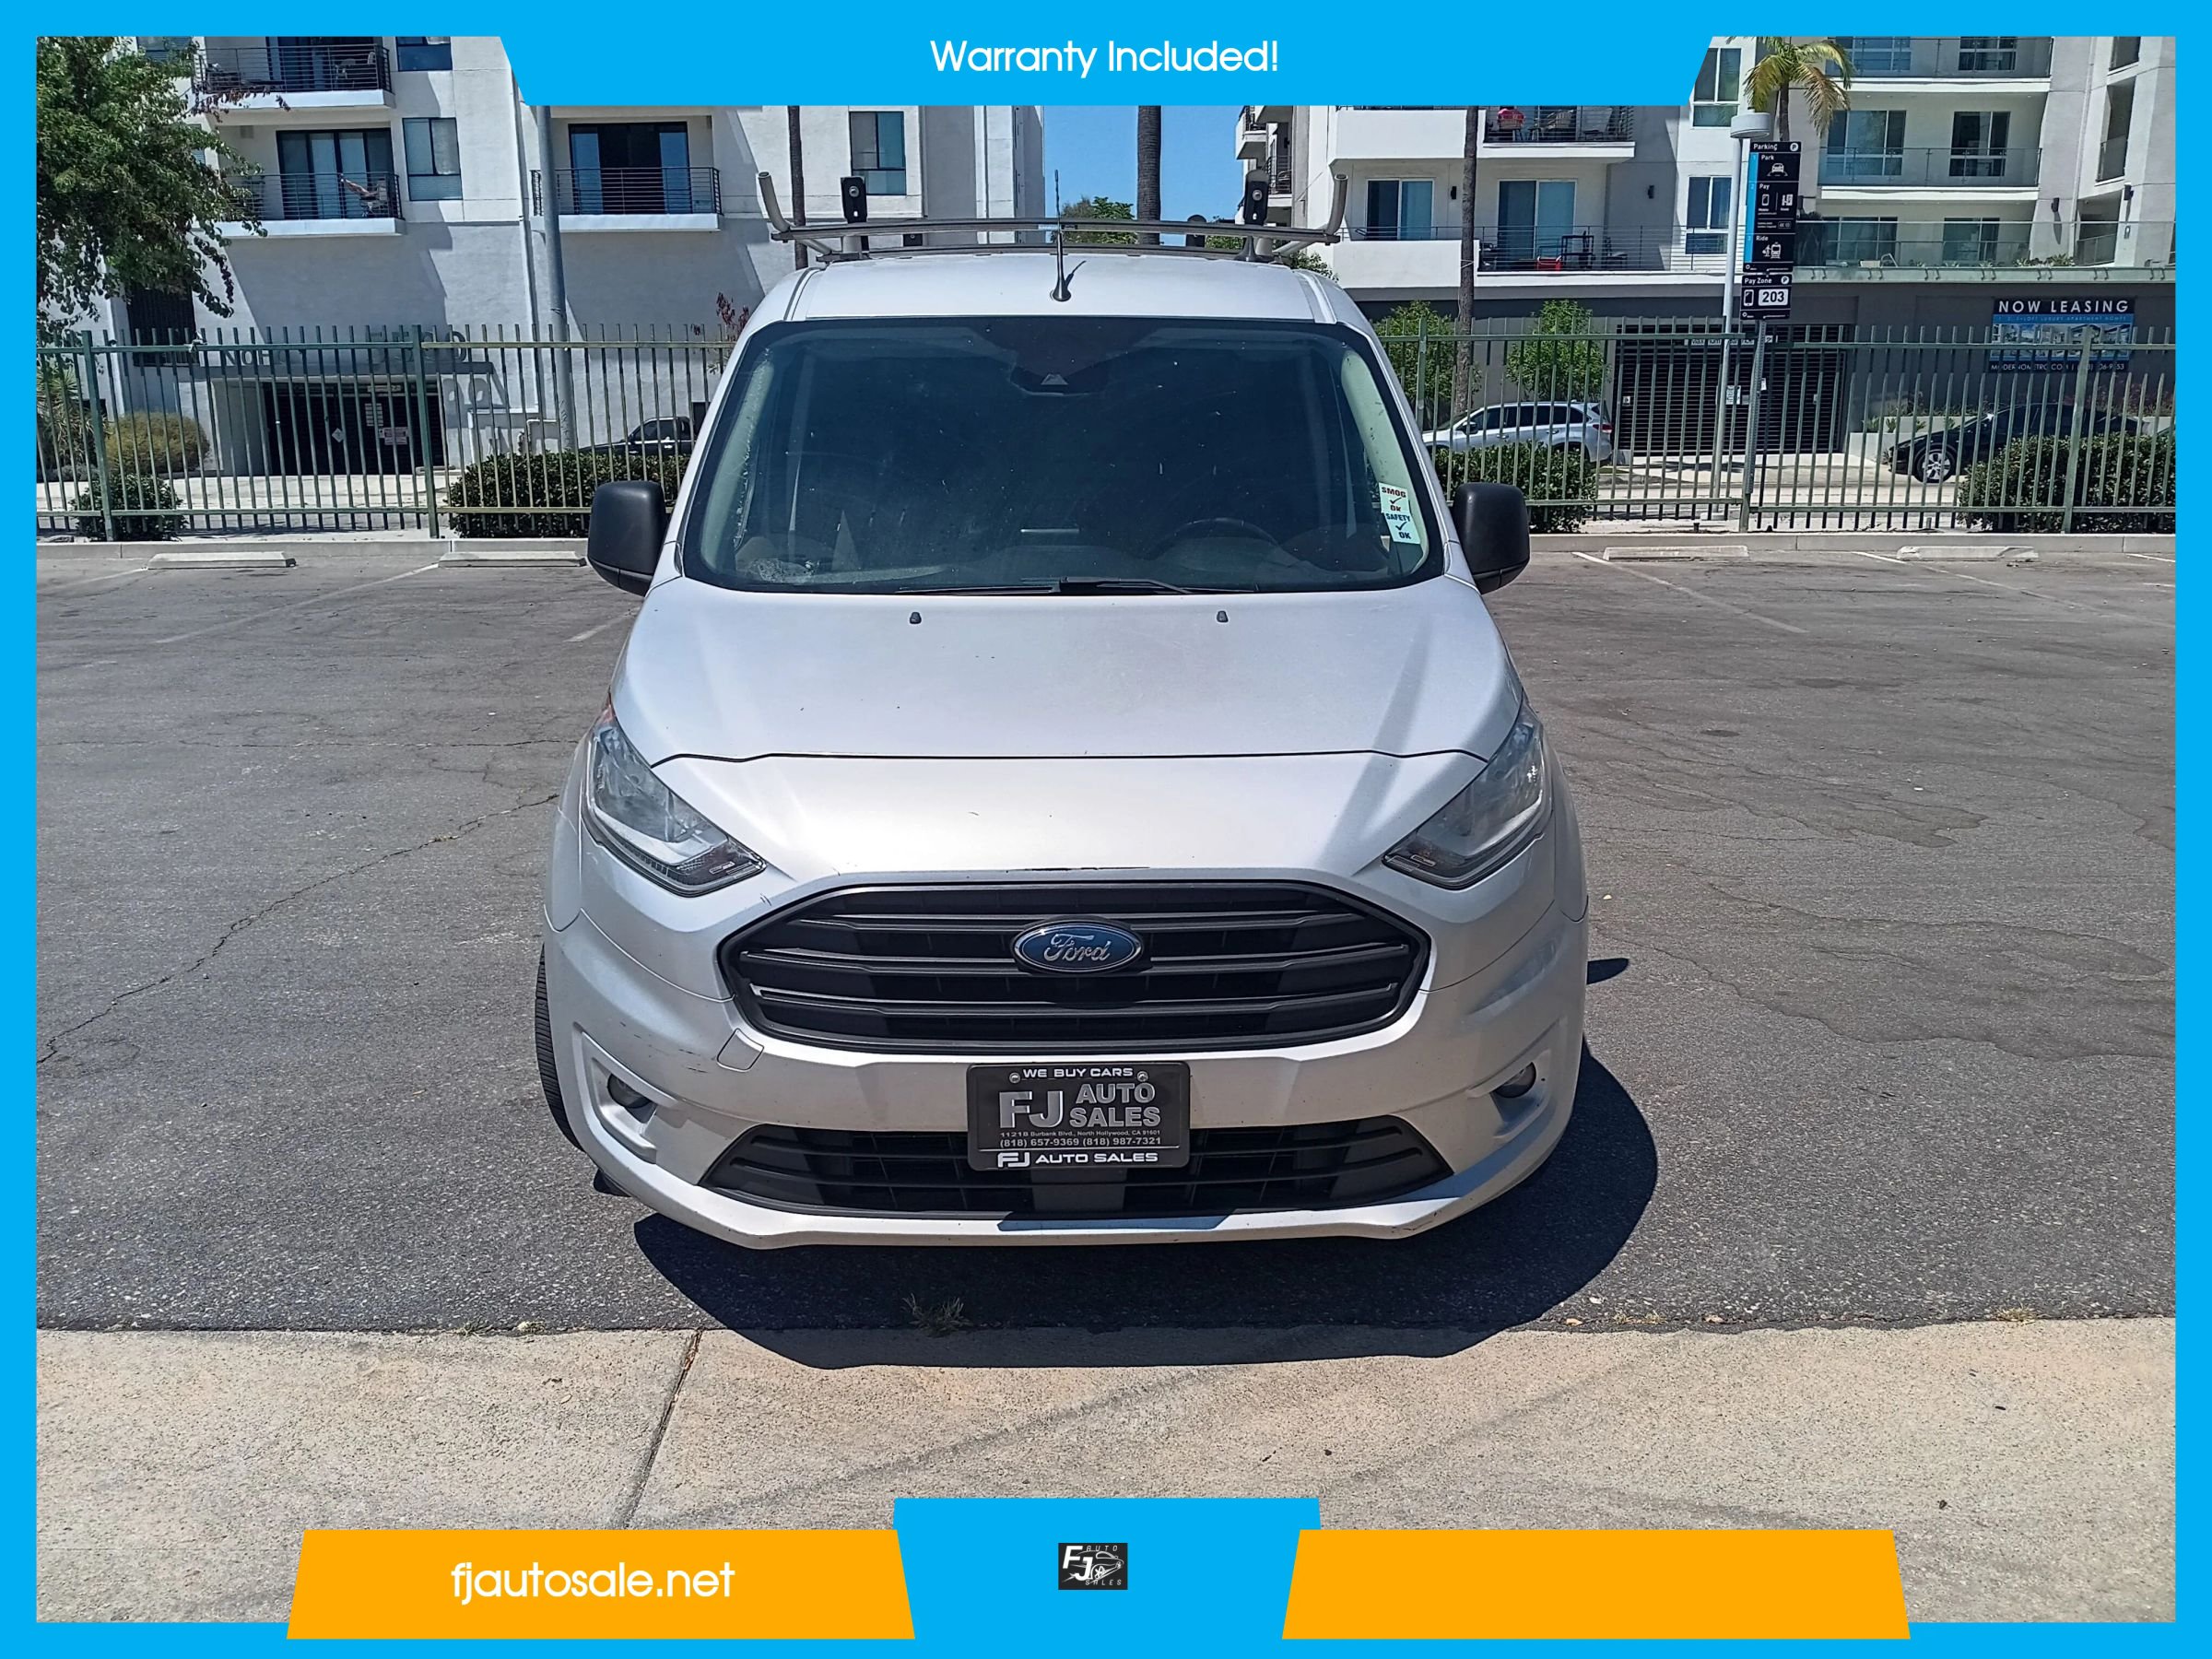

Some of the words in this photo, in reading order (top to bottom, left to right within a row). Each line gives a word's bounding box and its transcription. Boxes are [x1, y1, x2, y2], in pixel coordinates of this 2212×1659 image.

[1753, 143, 1778, 151] Parking
[1761, 291, 1784, 302] 203
[1998, 300, 2041, 313] NOW
[2050, 300, 2129, 313] LEASING
[1382, 487, 1406, 498] SMOG
[1385, 513, 1411, 522] SAFETY
[1043, 933, 1112, 961] Ford
[1023, 1068, 1047, 1077] WE
[1053, 1068, 1086, 1077] BUY
[1090, 1067, 1134, 1077] CARS
[998, 1090, 1064, 1129] FJ
[1075, 1082, 1156, 1104] AUTO
[1068, 1106, 1161, 1128] SALES
[1000, 1138, 1028, 1148] (818)
[1030, 1137, 1079, 1147] 657-9369
[1082, 1137, 1110, 1147] (818)
[1112, 1136, 1161, 1146] 987-7321
[997, 1151, 1031, 1168] FJ
[1035, 1153, 1088, 1164] AUTO
[1093, 1152, 1159, 1163] SALES
